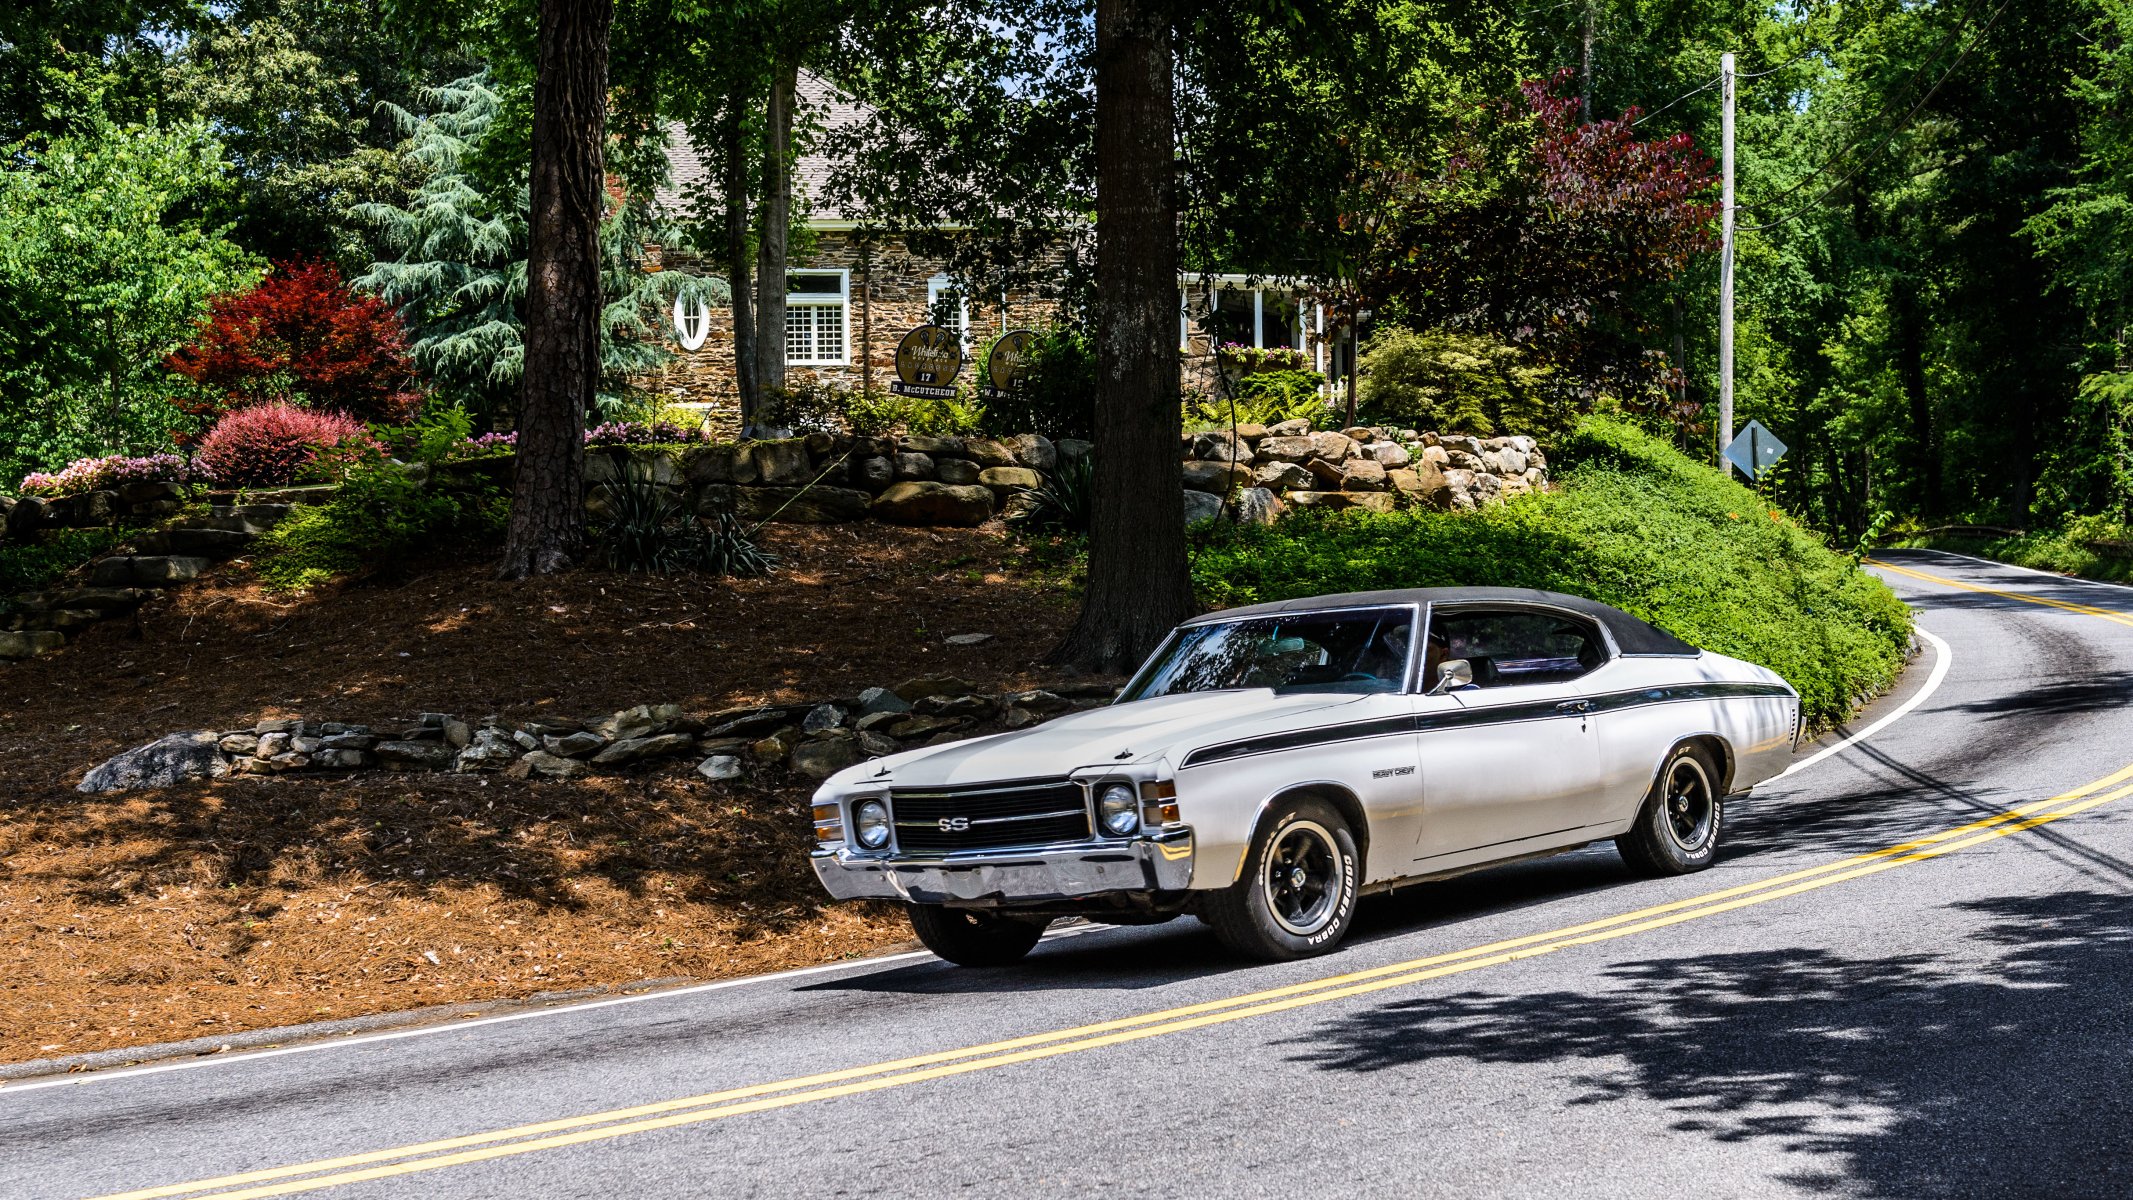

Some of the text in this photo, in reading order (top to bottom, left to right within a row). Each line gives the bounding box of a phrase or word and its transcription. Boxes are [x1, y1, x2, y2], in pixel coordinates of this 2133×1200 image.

[920, 373, 931, 382] 17
[1372, 766, 1416, 779] HEAVY CHEVY
[938, 817, 970, 832] SS
[1686, 802, 1721, 860] COOPER COBRA
[1307, 854, 1353, 946] COOPER COBRA
